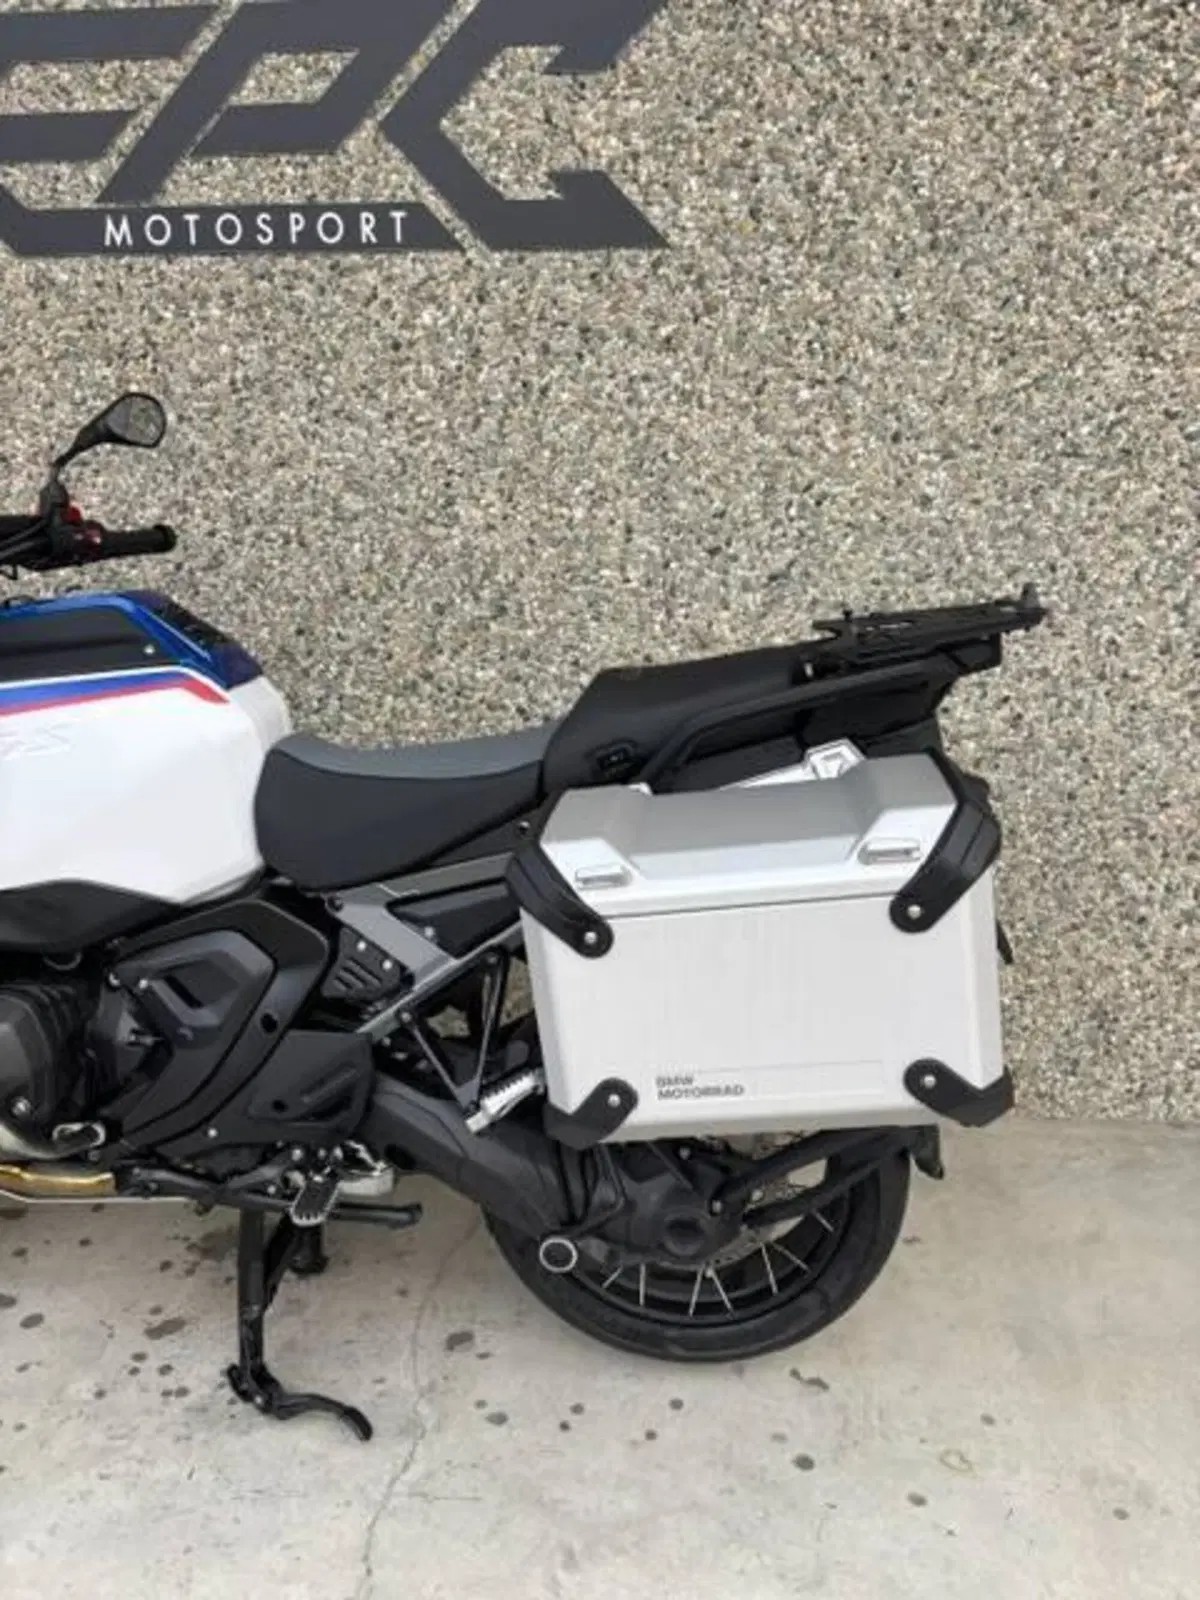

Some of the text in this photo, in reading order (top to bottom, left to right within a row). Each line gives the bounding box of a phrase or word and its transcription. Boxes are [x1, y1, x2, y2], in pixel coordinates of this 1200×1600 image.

[104, 211, 408, 247] MOTOSPORT
[655, 1075, 694, 1088] BMW
[657, 1084, 745, 1100] MOTORRAD
